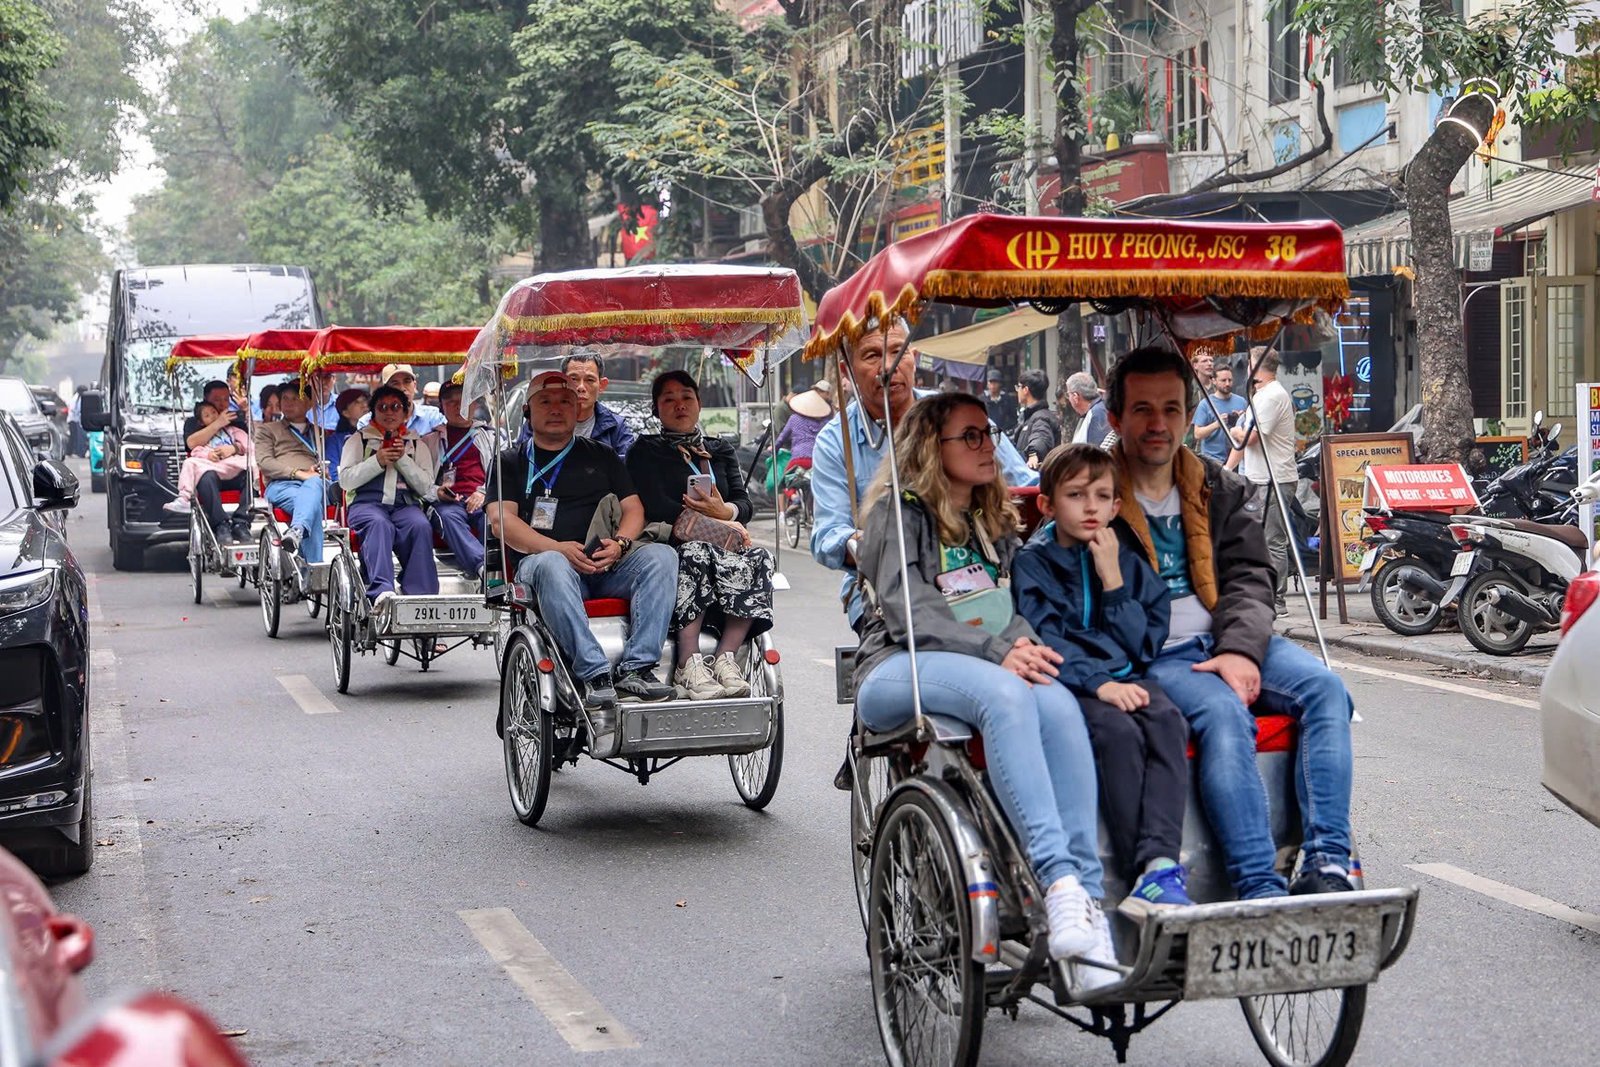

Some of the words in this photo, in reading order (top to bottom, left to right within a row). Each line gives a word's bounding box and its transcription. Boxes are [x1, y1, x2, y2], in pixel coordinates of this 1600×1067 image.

[1067, 233, 1116, 260] HUY
[1264, 235, 1297, 262] 38
[1370, 446, 1402, 455] BRUNCH
[1384, 470, 1453, 483] MOTORBIKES
[1385, 488, 1401, 500] FOR
[1401, 488, 1422, 500] RENT
[1426, 488, 1447, 500] SALE
[1450, 487, 1468, 499] BUY
[414, 607, 477, 620] 29XL-0170
[1211, 930, 1356, 973] 29XL-0073
